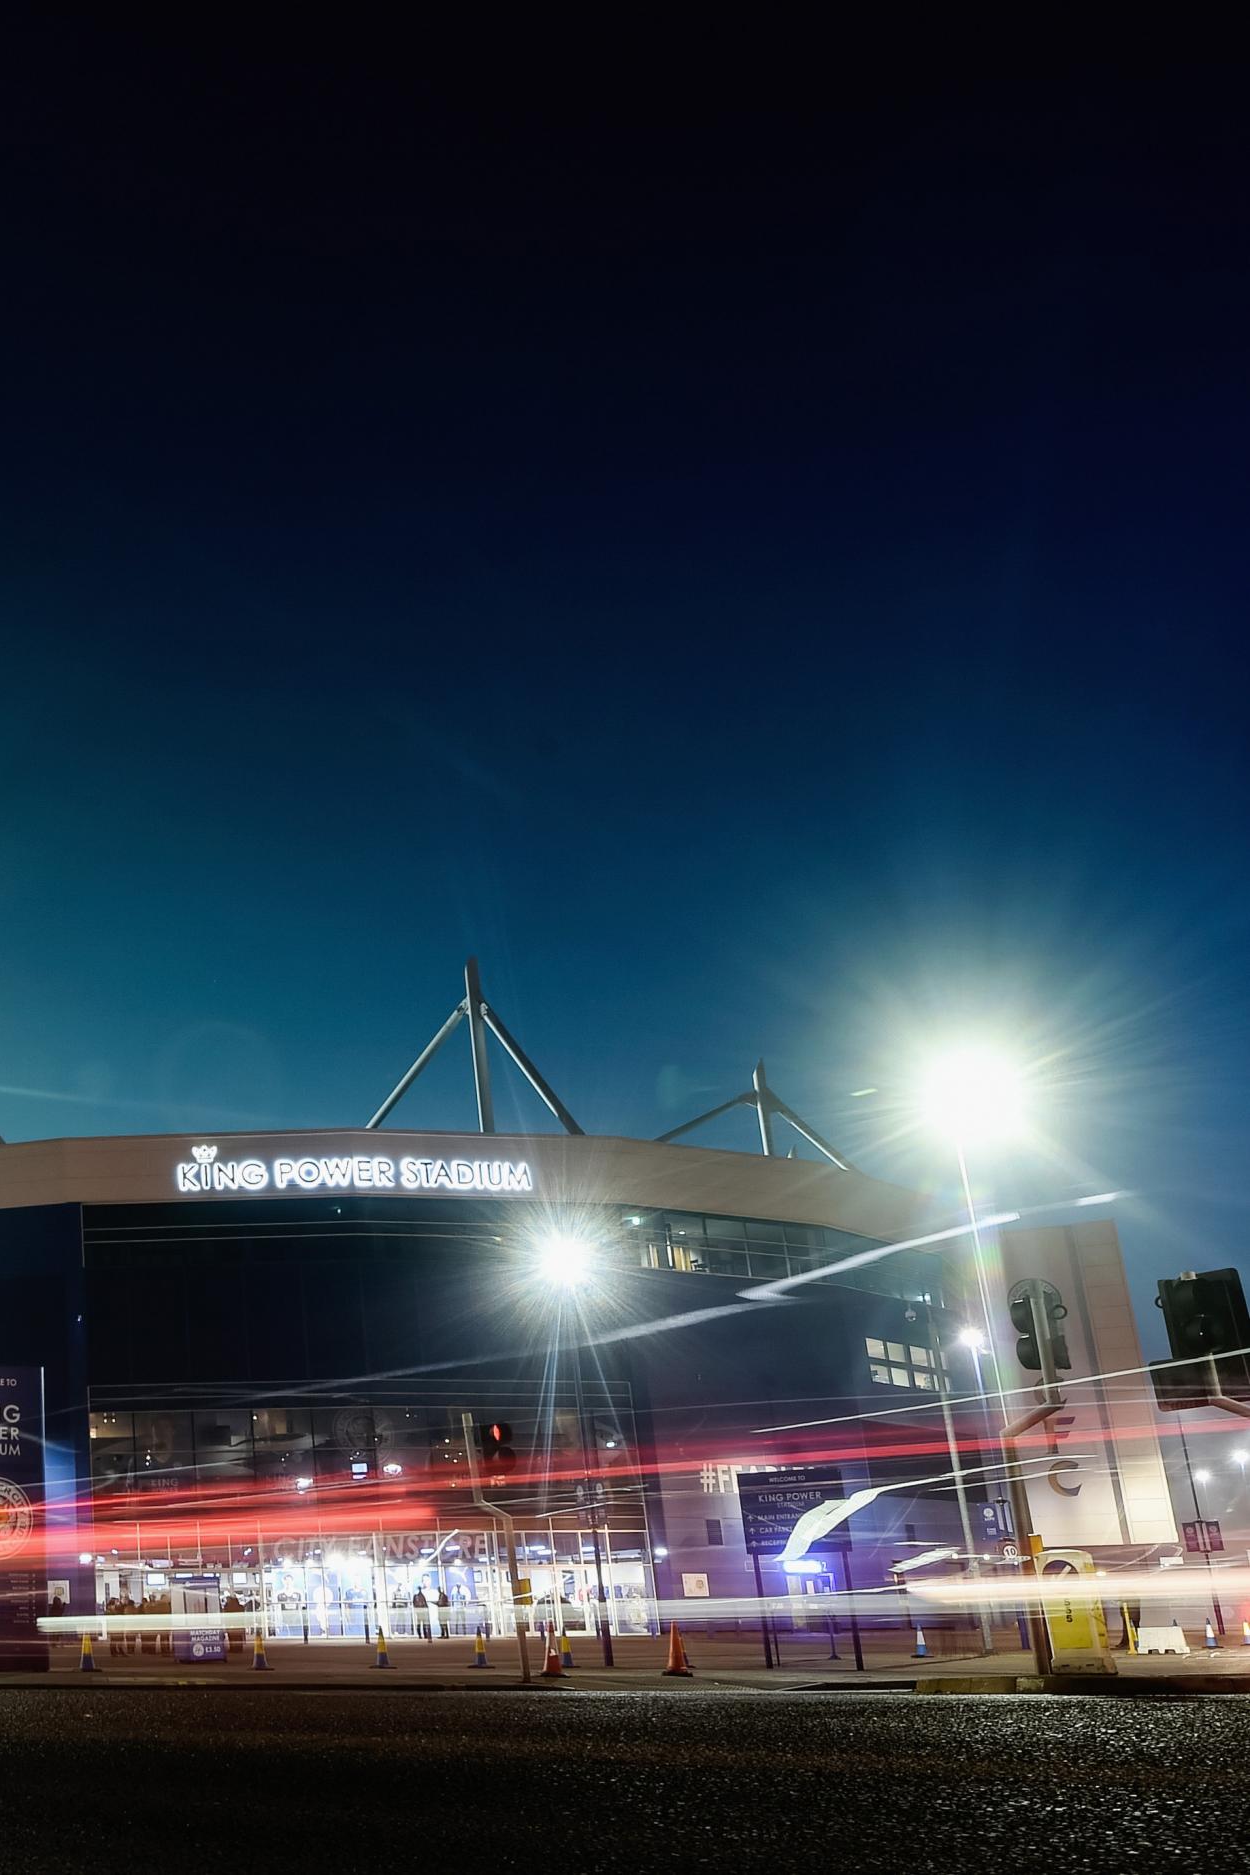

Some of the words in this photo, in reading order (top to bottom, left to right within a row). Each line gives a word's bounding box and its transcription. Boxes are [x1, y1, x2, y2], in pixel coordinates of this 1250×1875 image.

[178, 1161, 266, 1190] KING
[277, 1158, 393, 1188] POWER
[403, 1158, 532, 1190] STADIUM
[6, 1378, 17, 1387] TO
[758, 1493, 784, 1503] KING
[786, 1491, 822, 1501] POWER
[1005, 1547, 1016, 1557] 10
